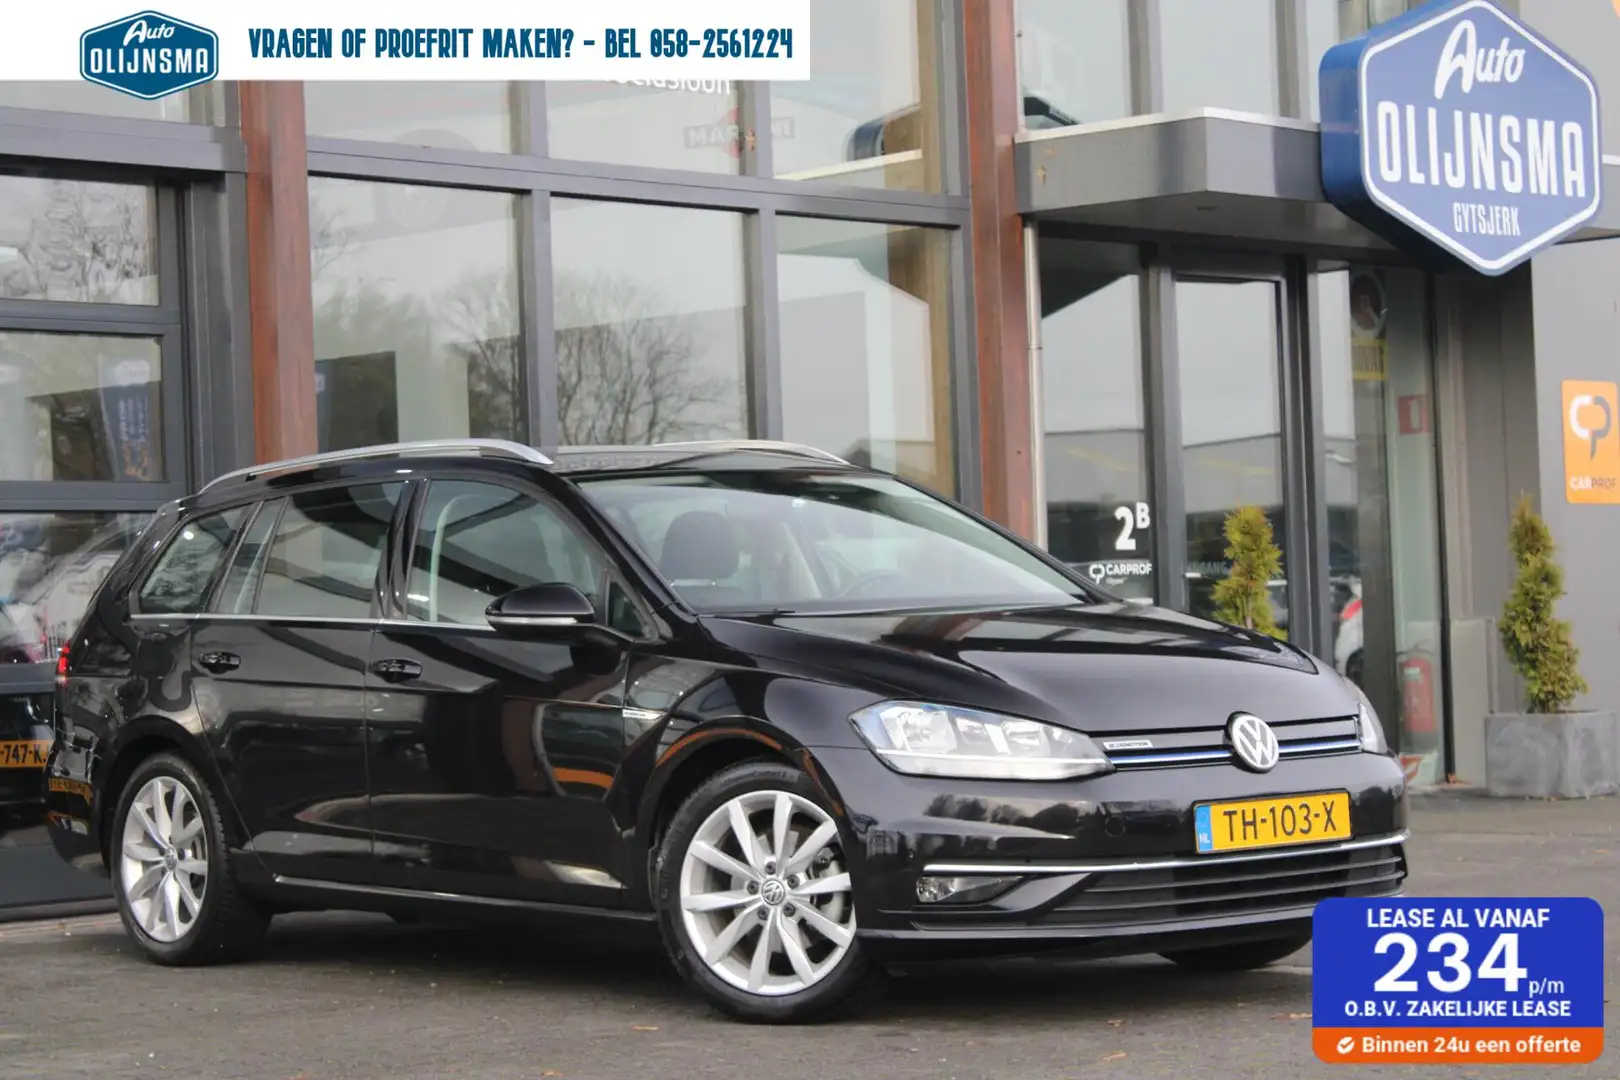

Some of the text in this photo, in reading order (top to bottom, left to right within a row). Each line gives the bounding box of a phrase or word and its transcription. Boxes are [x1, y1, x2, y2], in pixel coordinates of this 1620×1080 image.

[1434, 19, 1527, 100] Auto
[688, 118, 791, 148] MARNI
[1377, 101, 1586, 198] OLIJNSMA
[1453, 202, 1521, 236] GYTSJERK
[1568, 475, 1618, 490] CARPROF
[1106, 563, 1152, 575] CARPROF
[1223, 800, 1337, 842] TH-103-X
[1199, 833, 1211, 844] NL
